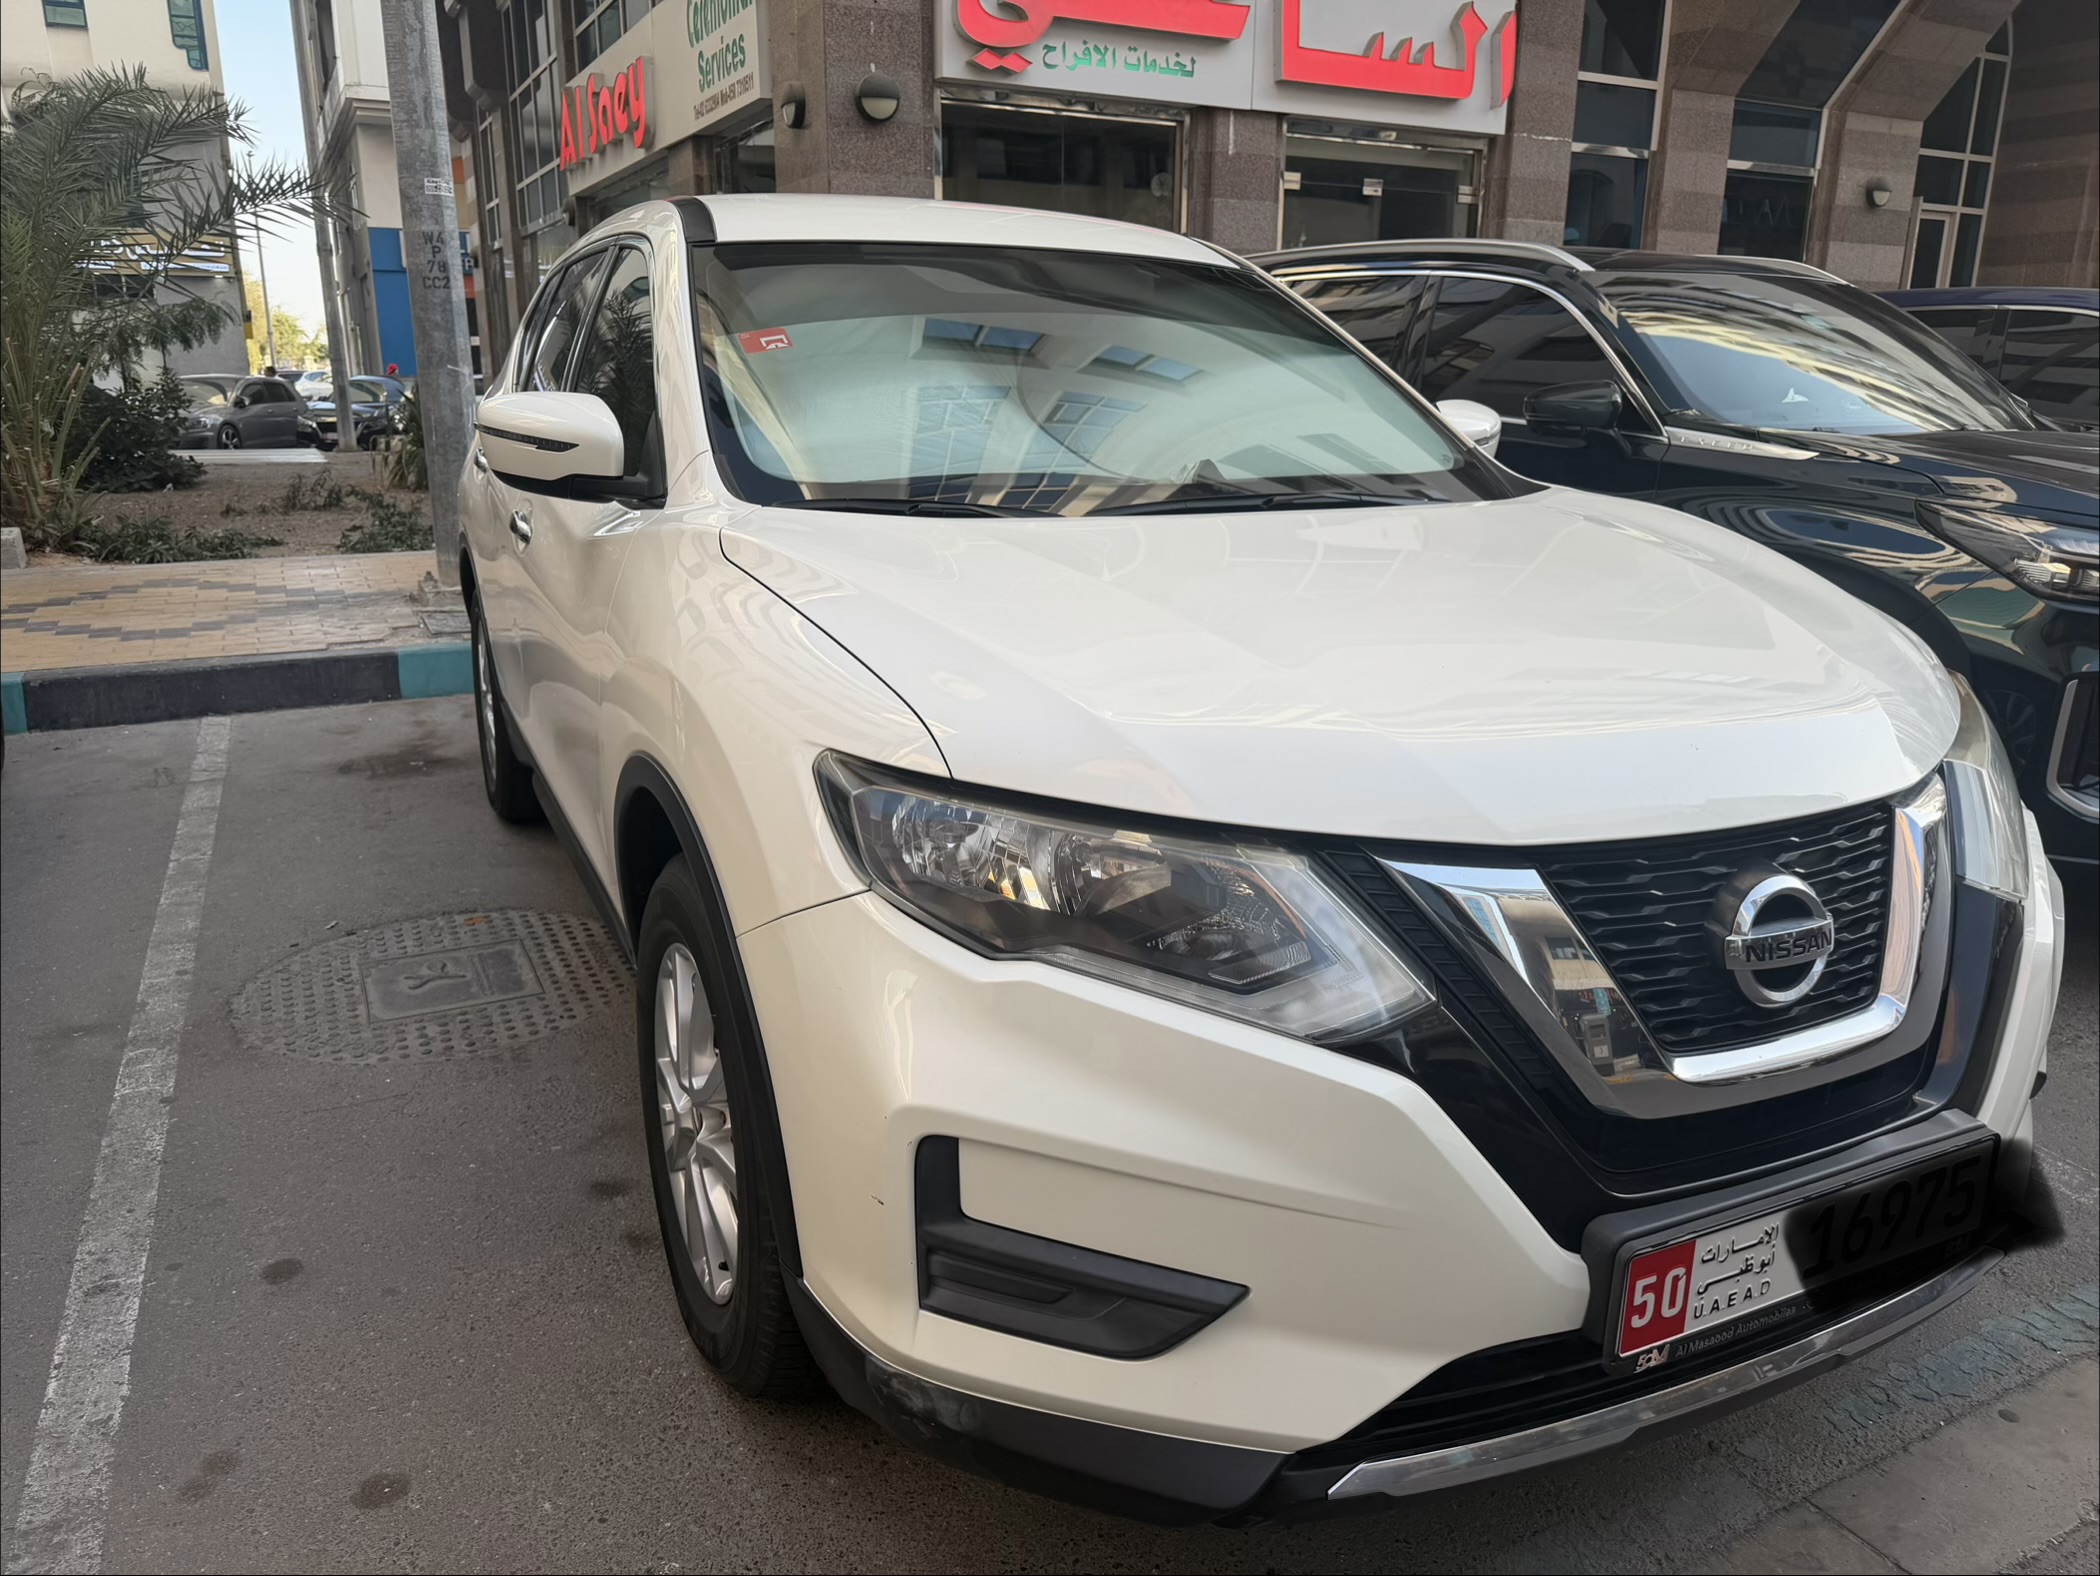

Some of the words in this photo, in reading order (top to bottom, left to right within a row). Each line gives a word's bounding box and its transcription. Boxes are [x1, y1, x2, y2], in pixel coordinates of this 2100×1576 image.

[698, 34, 746, 93] Services
[1123, 45, 1197, 78] لخدمات
[427, 260, 447, 273] 78
[432, 245, 442, 259] P
[423, 276, 451, 289] CC2
[1745, 927, 1832, 963] NISSAN
[1630, 1266, 1687, 1329] 50
[1803, 1155, 1982, 1279] 16975
[1736, 1306, 1796, 1336] Automobiles
